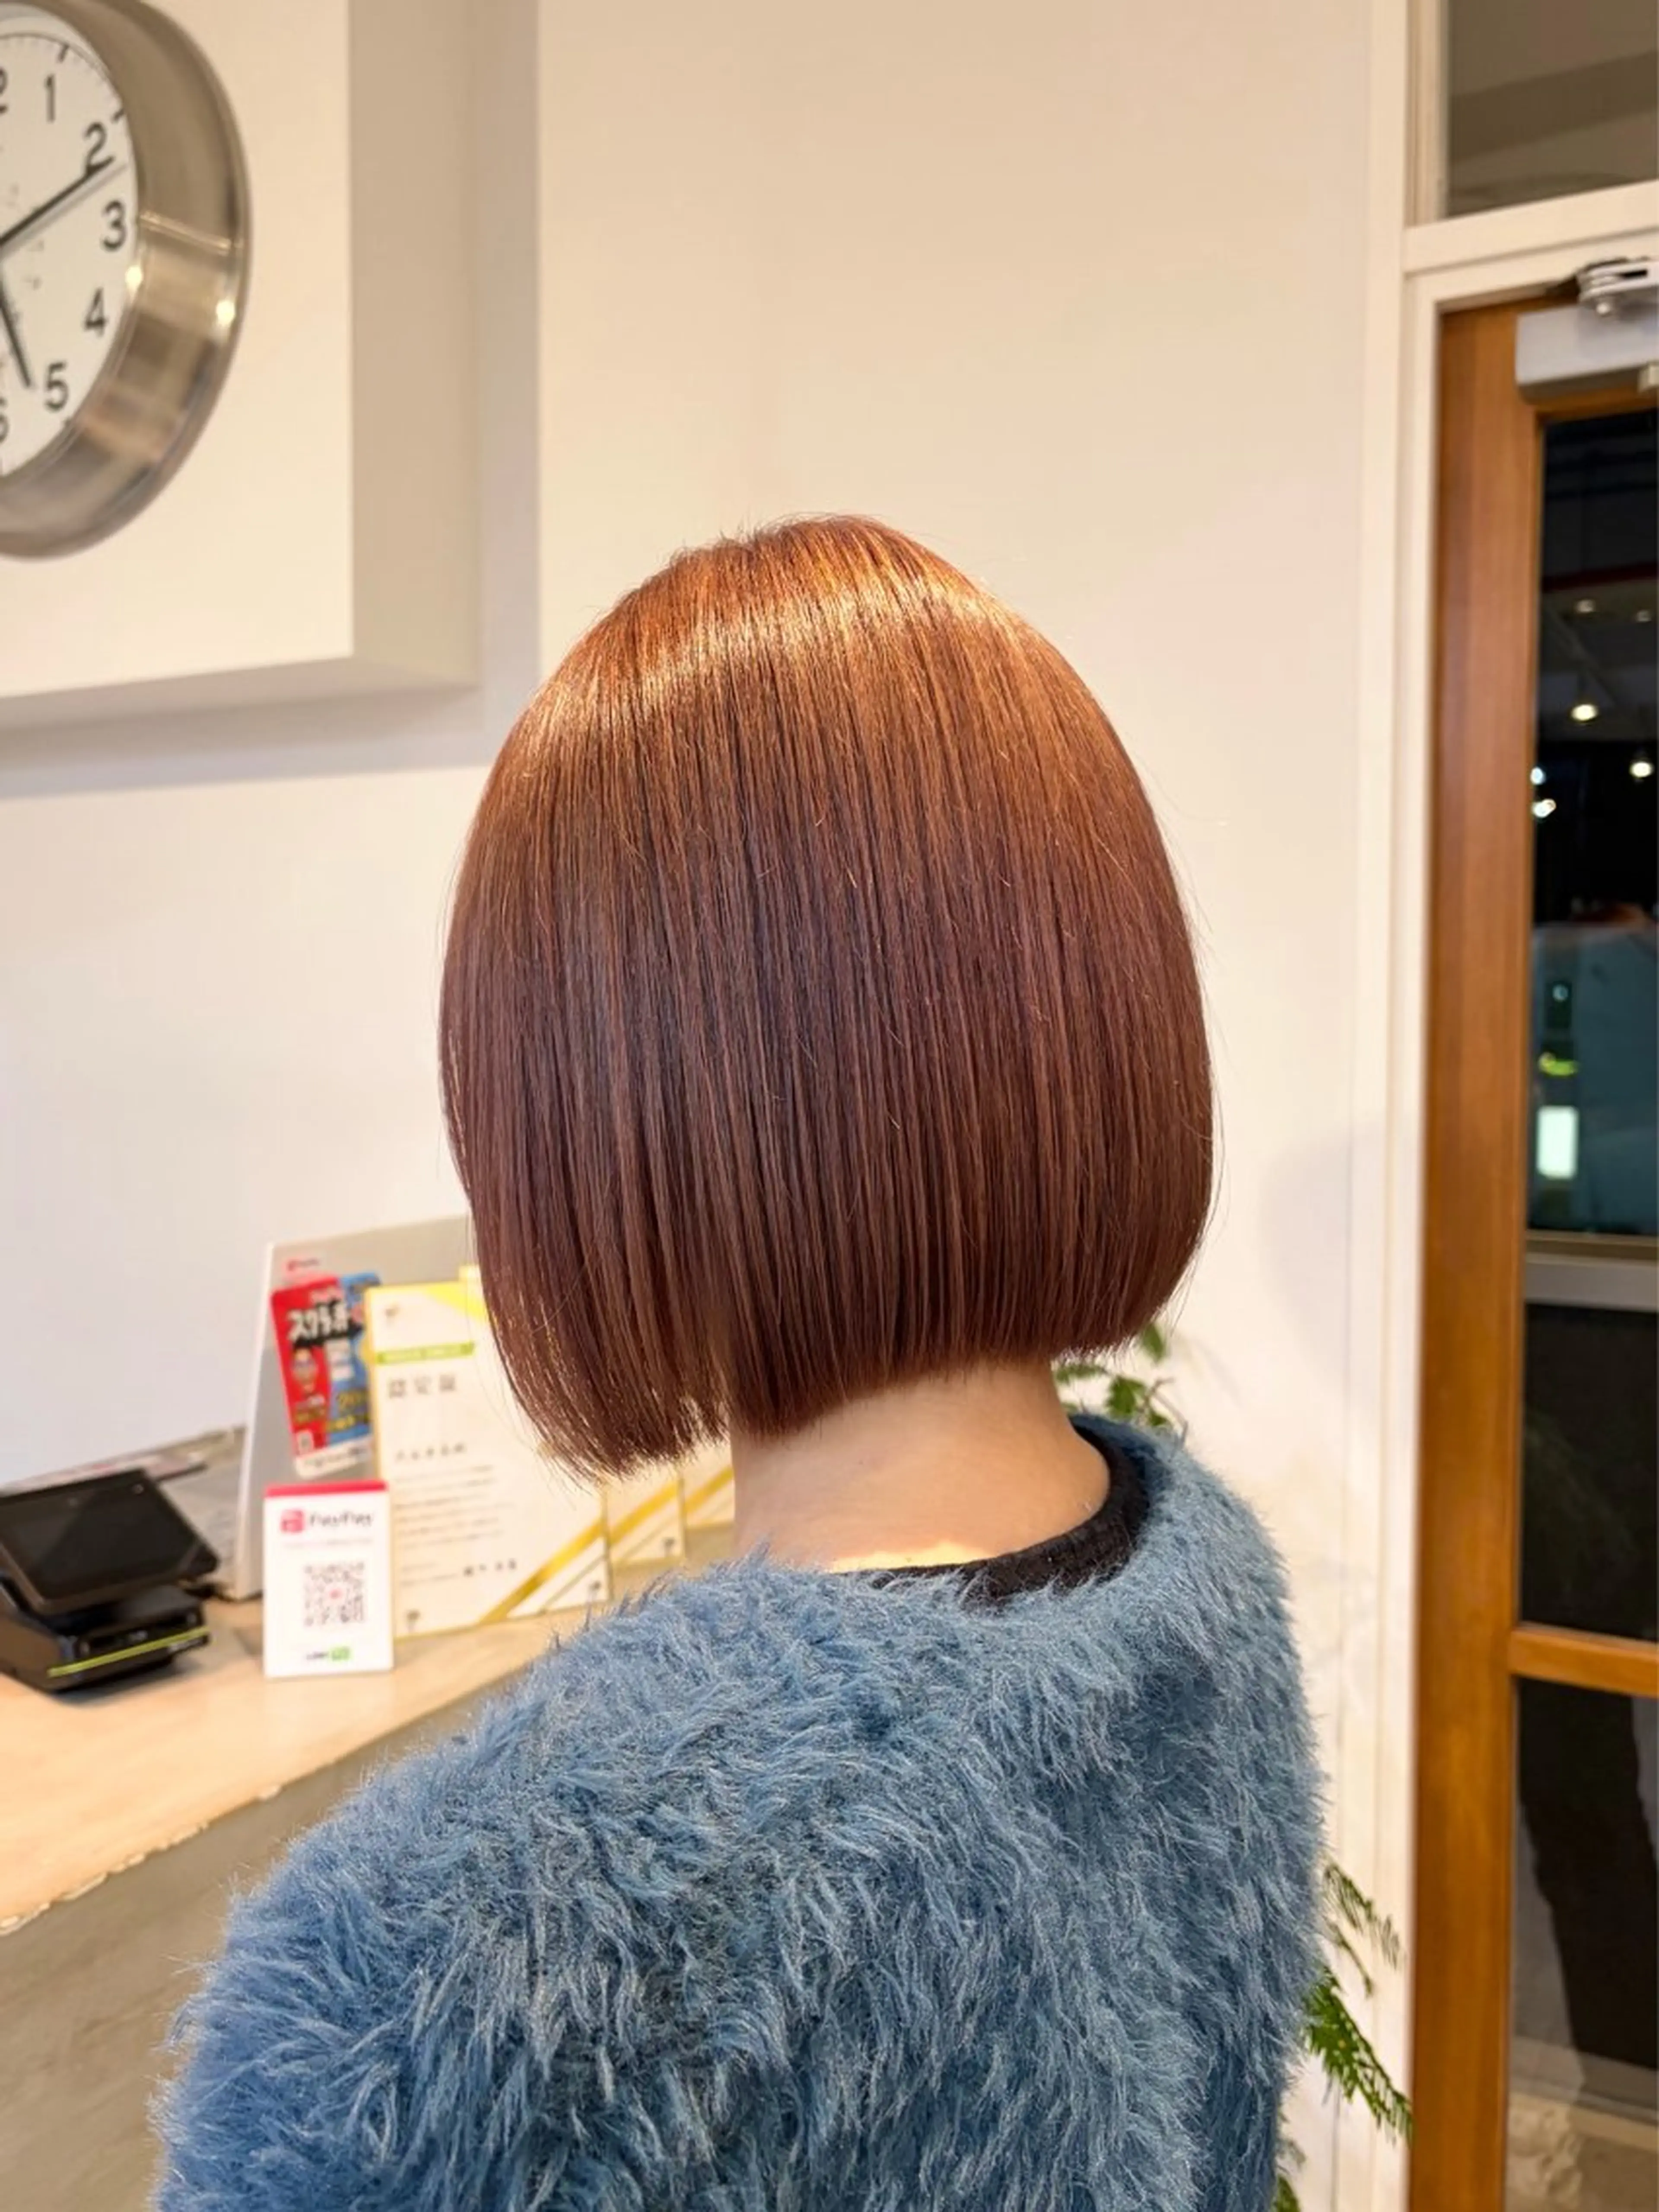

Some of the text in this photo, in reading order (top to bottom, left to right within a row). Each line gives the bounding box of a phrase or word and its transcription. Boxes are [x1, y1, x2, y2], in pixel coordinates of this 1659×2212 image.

[44, 74, 55, 123] 1
[84, 121, 114, 173] 2
[102, 200, 127, 252] 3
[84, 287, 109, 337] 4
[44, 361, 69, 411] 5
